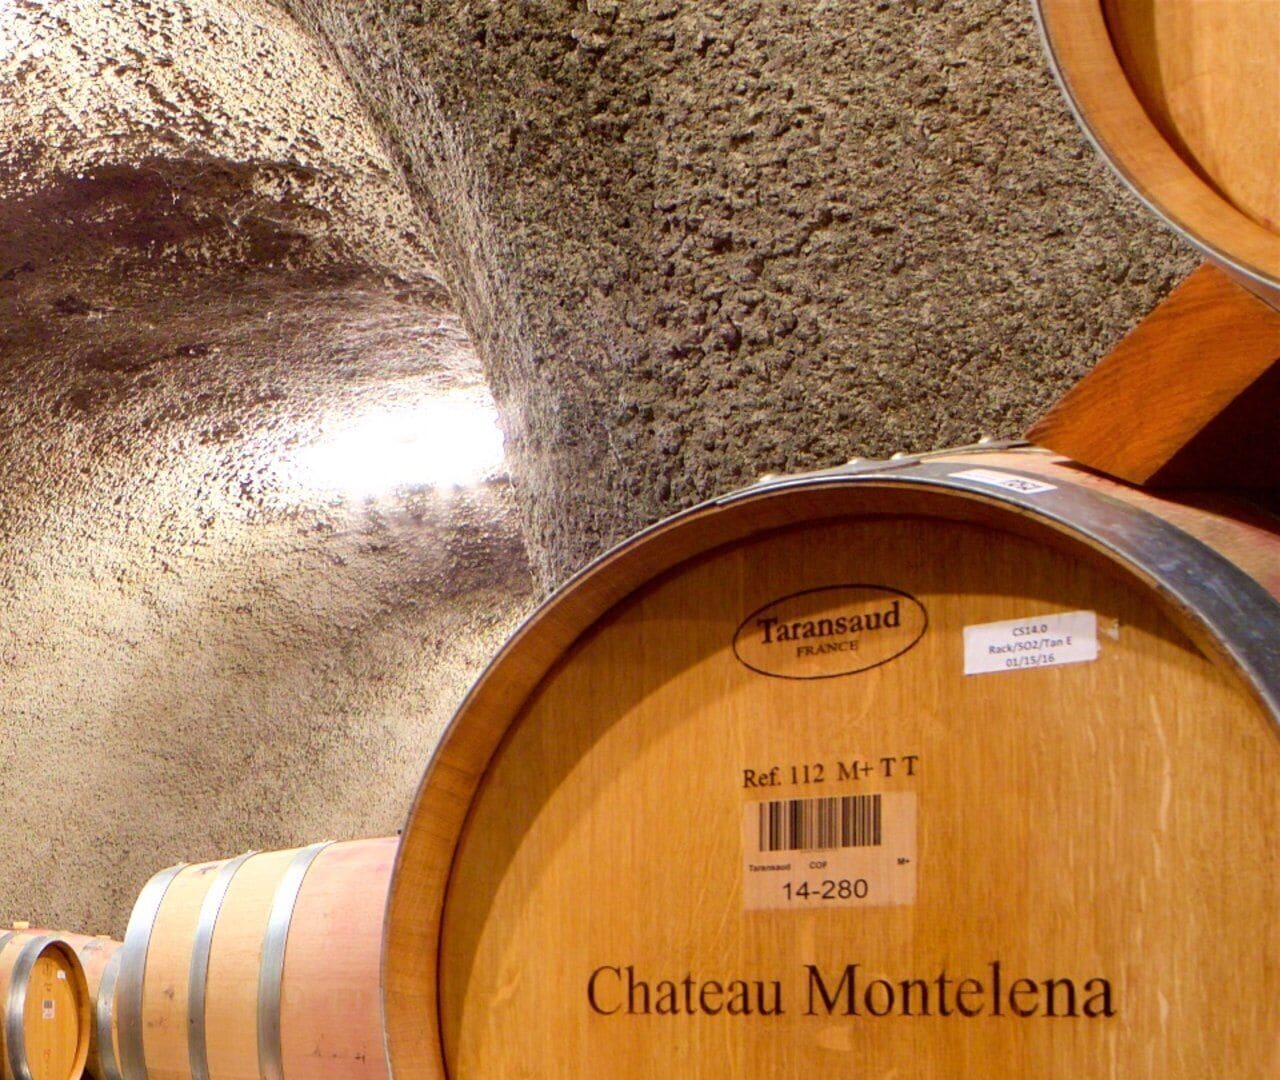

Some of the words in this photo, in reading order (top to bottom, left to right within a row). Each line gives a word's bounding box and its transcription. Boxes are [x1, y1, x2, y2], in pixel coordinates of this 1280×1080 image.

[757, 600, 901, 645] Taransaud
[1012, 624, 1048, 637] CS14.0
[796, 639, 859, 658] FRANCE
[988, 638, 1064, 655] Rack/SO2/Tan
[1066, 636, 1073, 646] E
[1006, 653, 1056, 668] 01/15/16
[743, 767, 782, 788] Ref.
[791, 764, 825, 784] 112
[837, 760, 874, 781] M+
[782, 879, 869, 900] 14-280
[587, 965, 783, 1017] Chateau
[804, 961, 1118, 1018] Montelena
